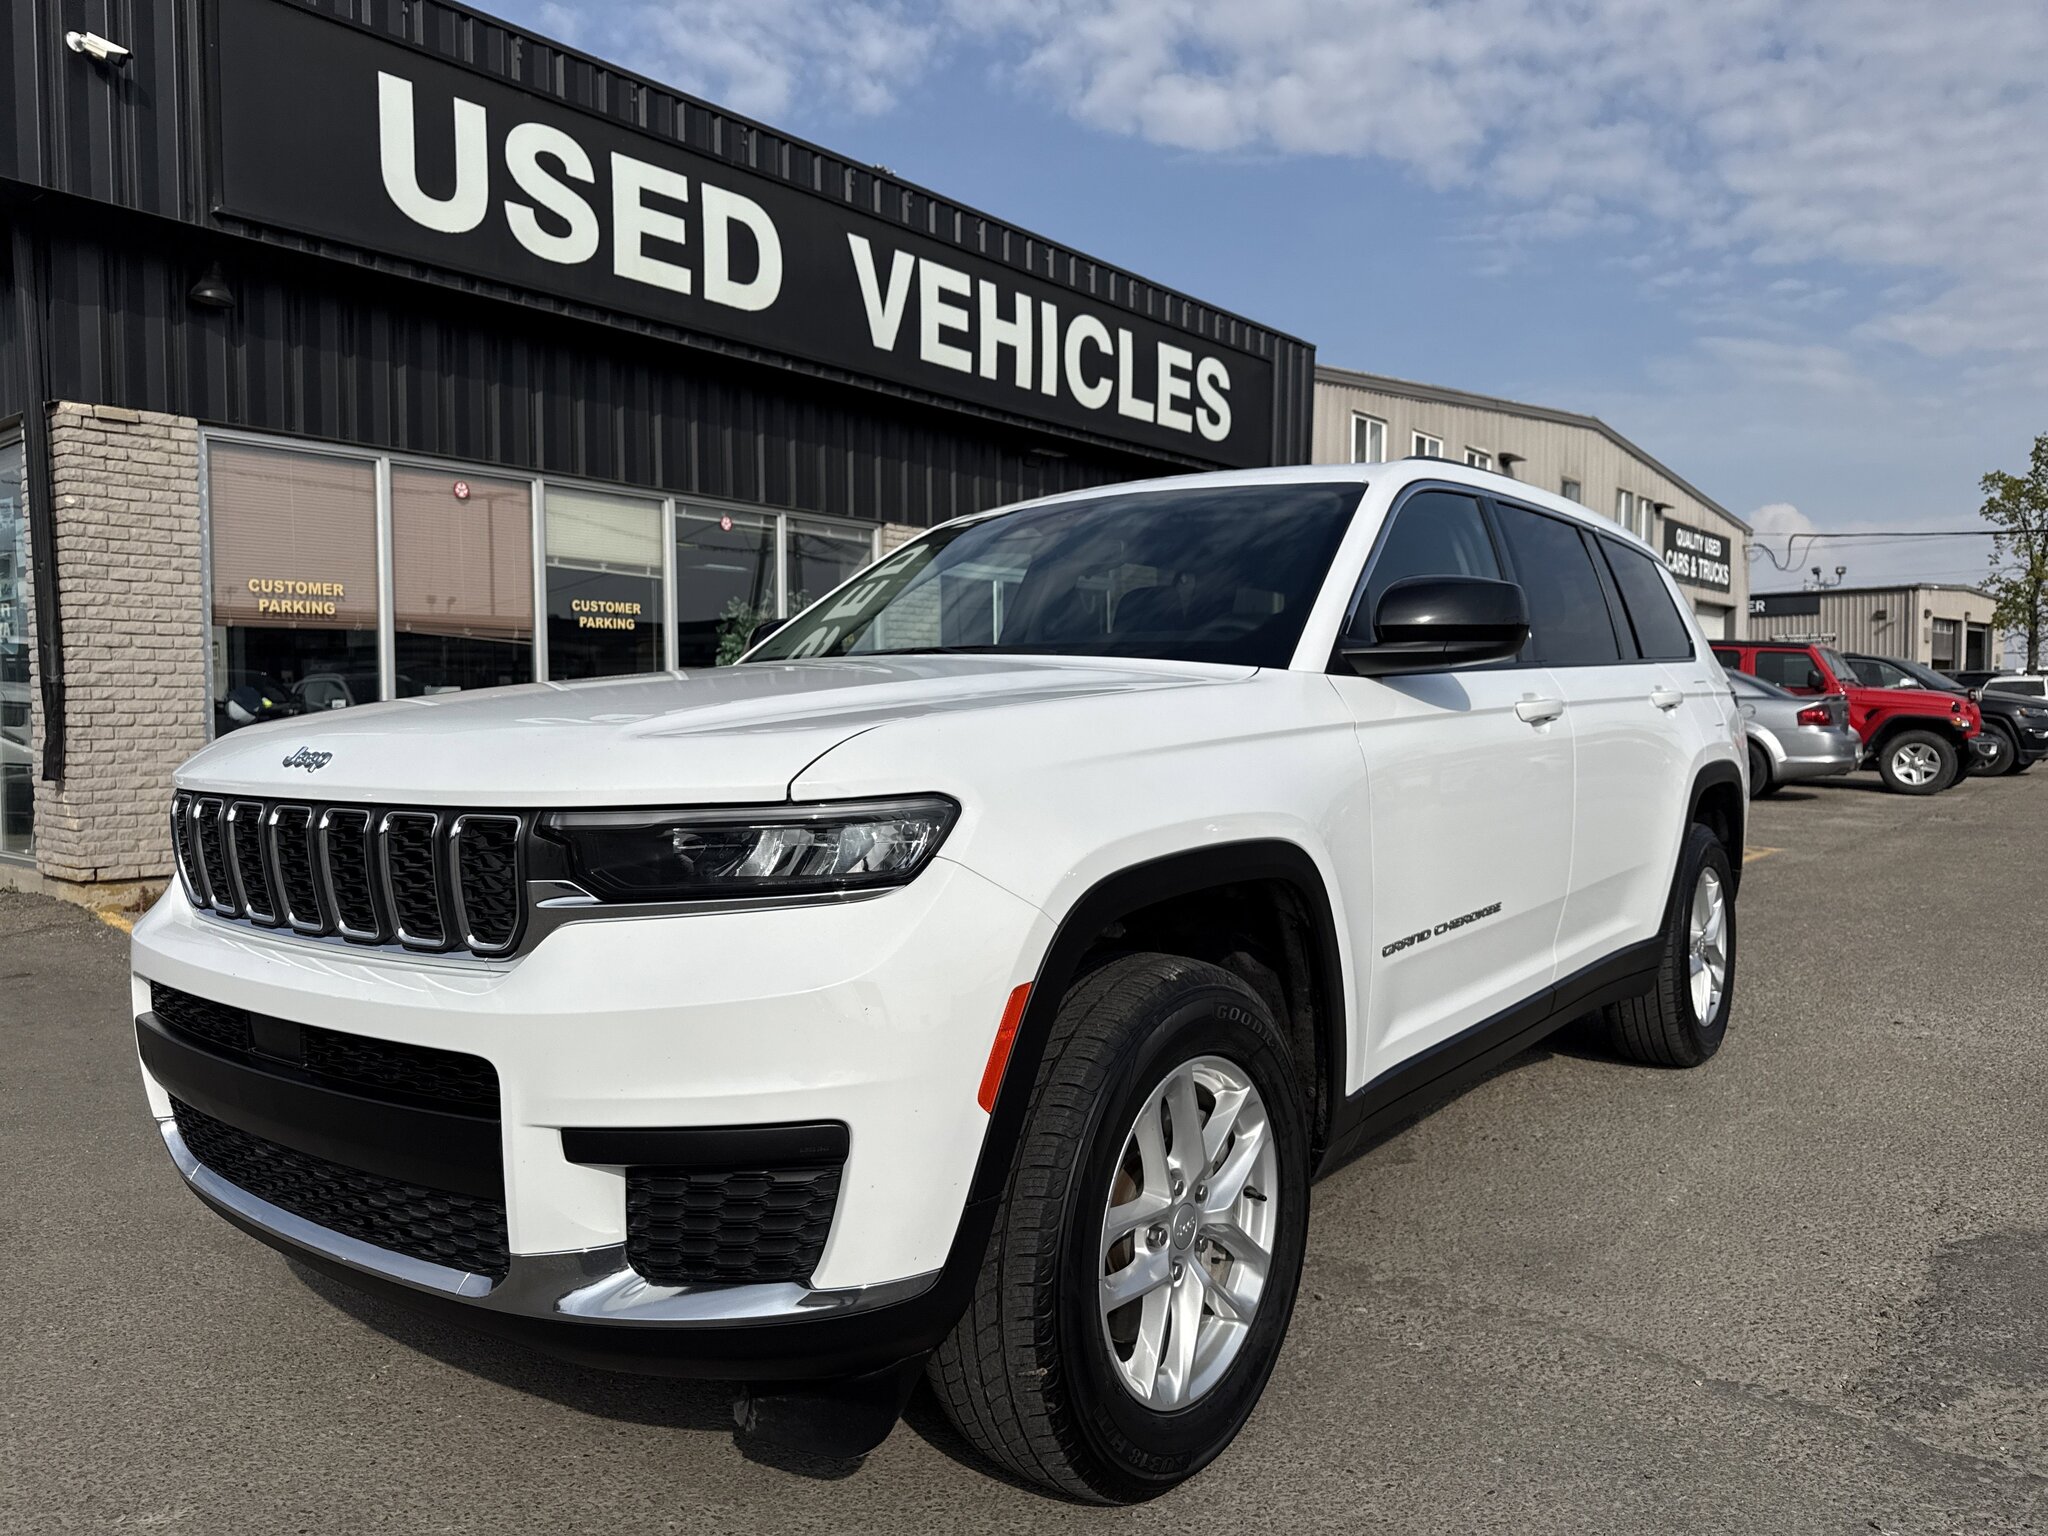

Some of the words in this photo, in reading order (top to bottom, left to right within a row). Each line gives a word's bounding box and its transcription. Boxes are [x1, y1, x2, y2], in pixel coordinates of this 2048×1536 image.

[377, 70, 783, 311] USED
[847, 232, 1232, 442] VEHICLES
[1676, 527, 1704, 552] QUALITY
[1704, 536, 1721, 557] USED
[1666, 549, 1690, 576] CARS
[1690, 556, 1698, 578] &
[1698, 557, 1729, 585] TRUCKS
[248, 578, 345, 597] CUSTOMER
[258, 598, 336, 616] PARKING
[571, 600, 641, 615] CUSTOMER
[579, 615, 635, 631] PARKING
[283, 746, 333, 773] Jeep
[1382, 929, 1432, 958] GRAND
[1433, 901, 1503, 936] CHEROKEE
